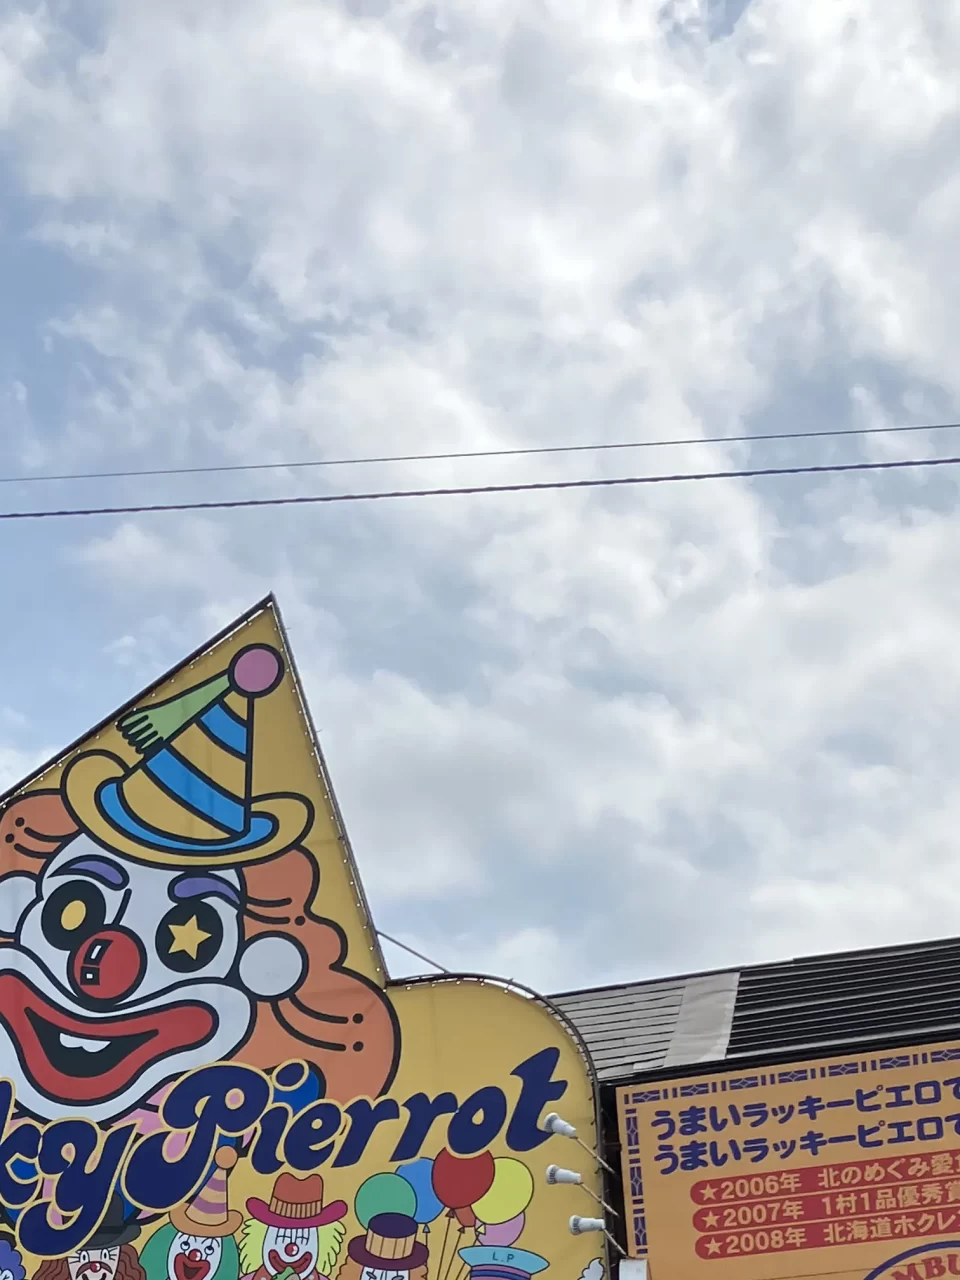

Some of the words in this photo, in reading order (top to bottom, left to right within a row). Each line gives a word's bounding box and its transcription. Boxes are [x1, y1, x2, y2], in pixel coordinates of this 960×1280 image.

[125, 1047, 569, 1209] Pierrot
[817, 1150, 960, 1188] 北のめぐみ愛
[824, 1207, 960, 1244] 北海道ホクレ
